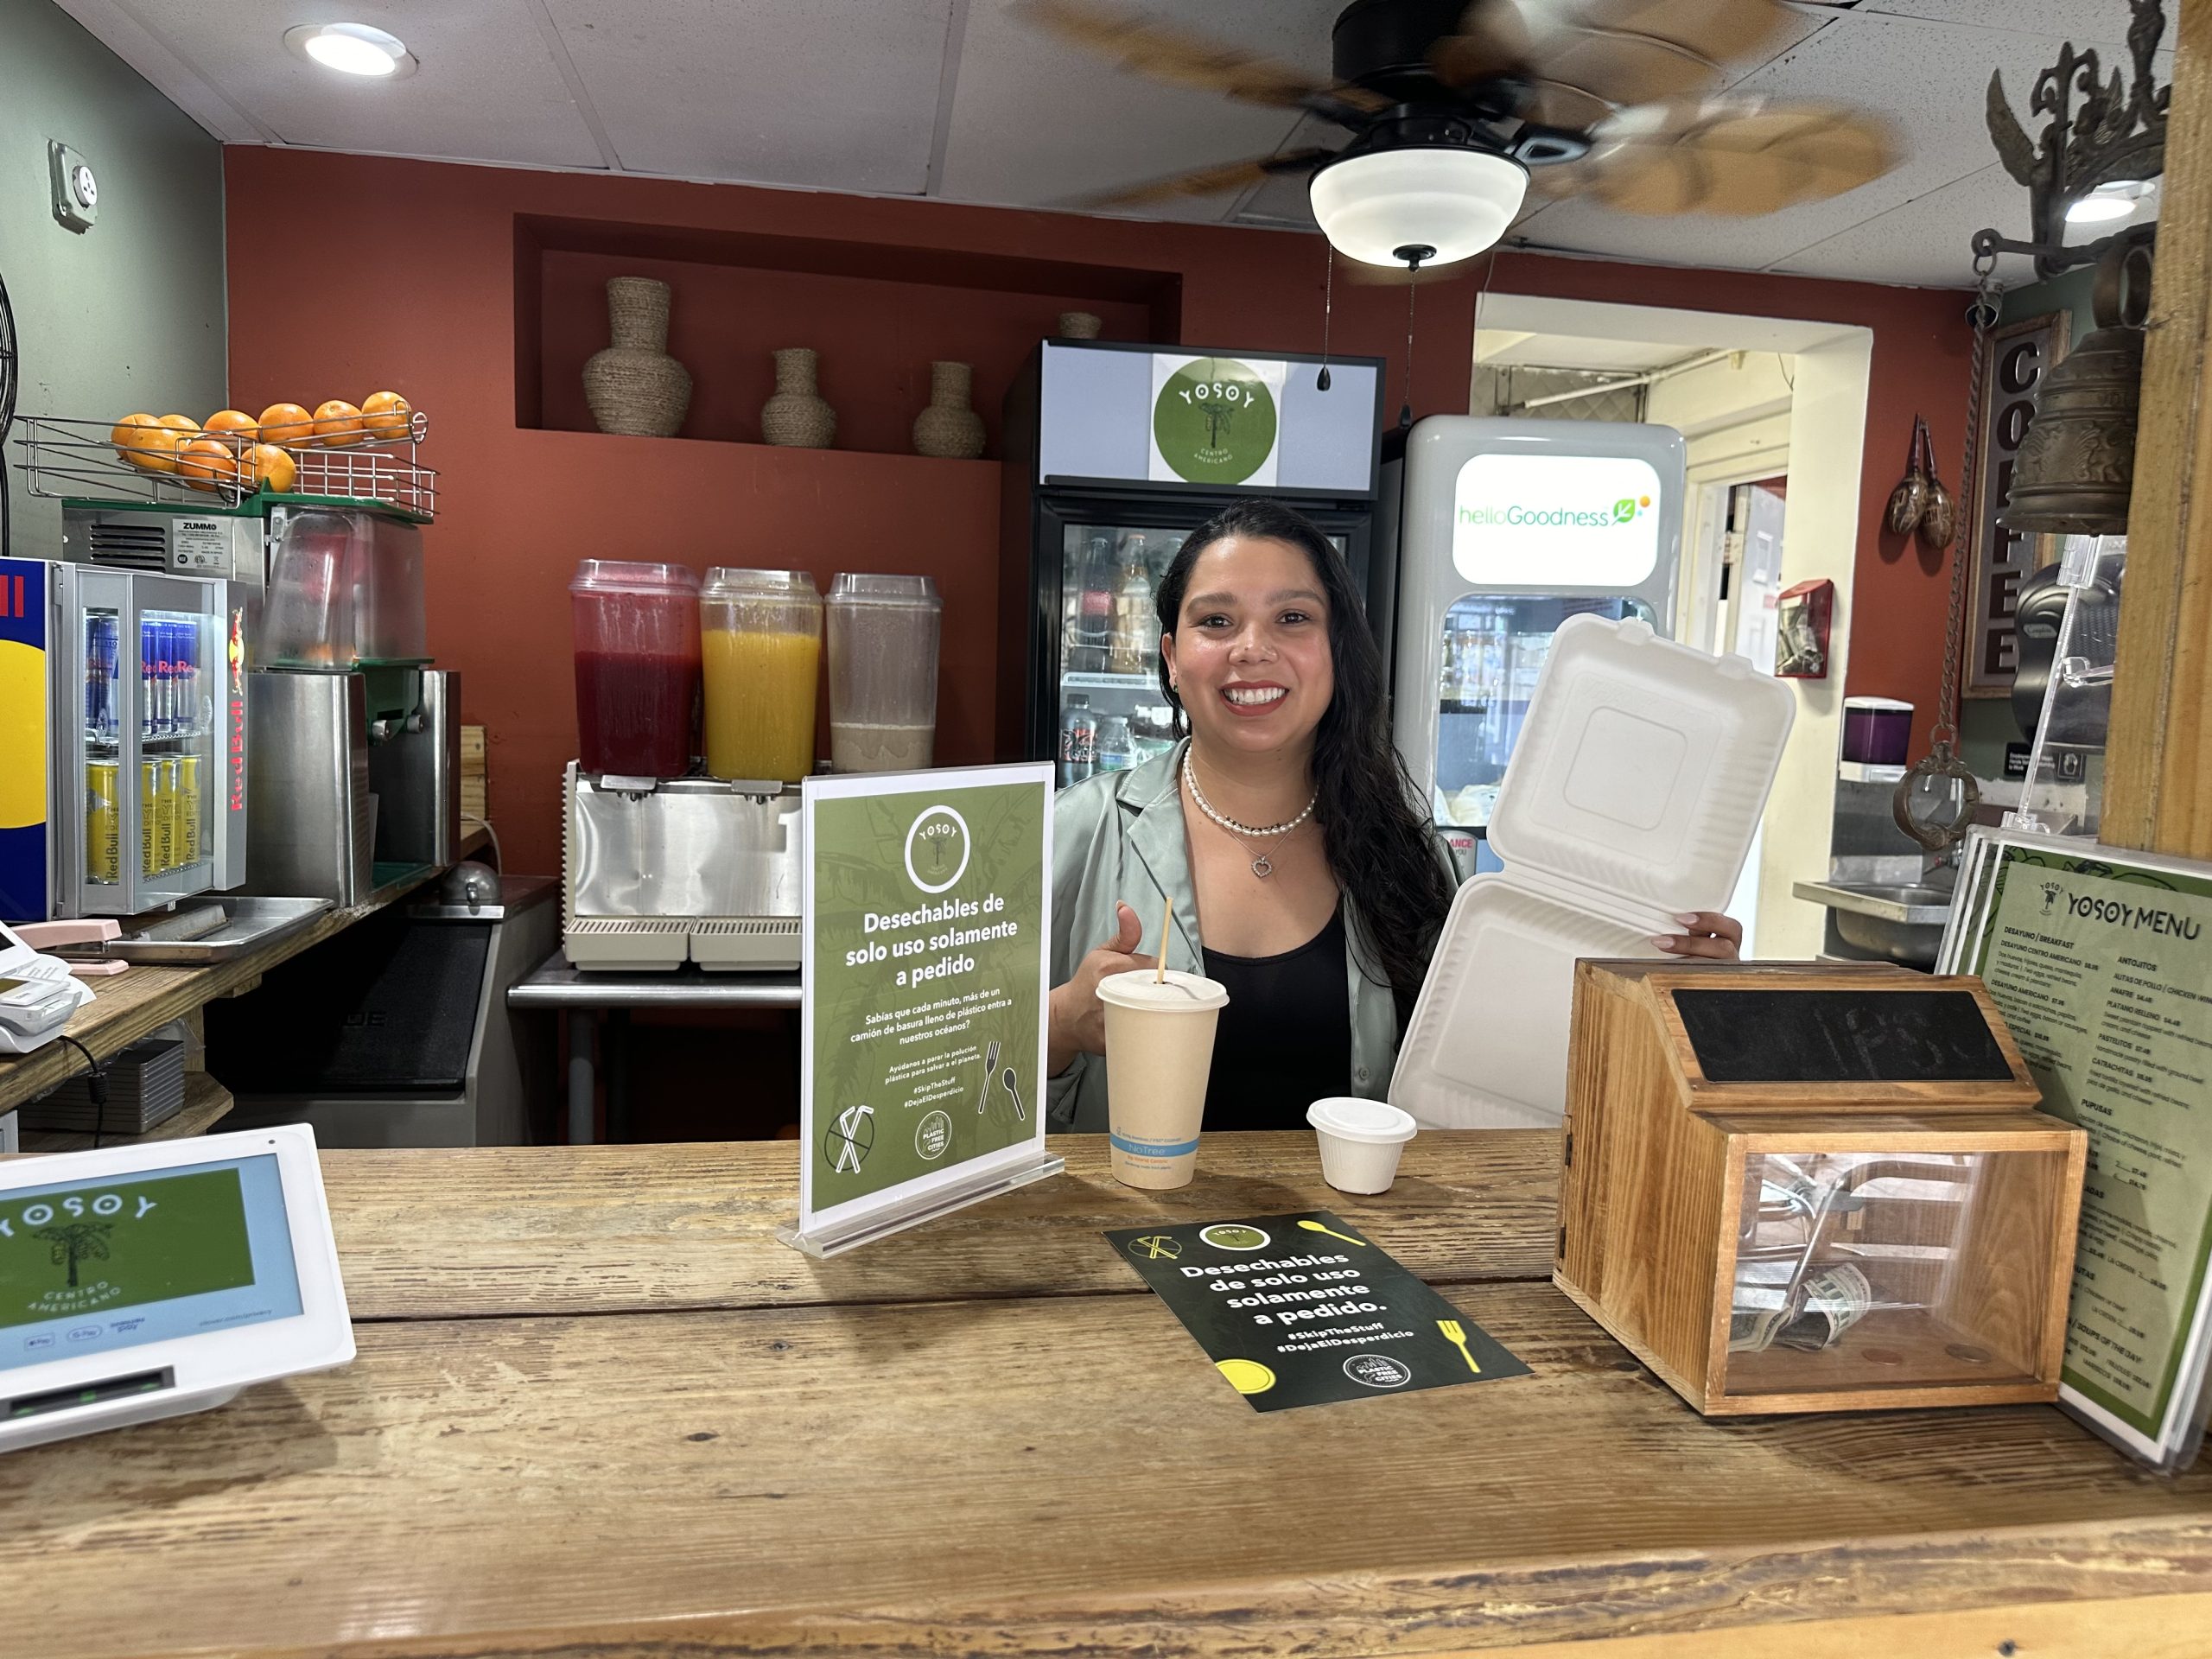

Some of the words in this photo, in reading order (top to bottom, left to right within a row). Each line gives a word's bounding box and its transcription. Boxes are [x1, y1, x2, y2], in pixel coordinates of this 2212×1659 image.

[1179, 382, 1255, 408] YOSOY
[1194, 454, 1233, 465] AMERICANO
[1201, 448, 1229, 456] CENTRO
[183, 522, 216, 531] ZUMMO
[1459, 505, 1609, 527] helloGoodness
[231, 702, 243, 753] Bull
[231, 757, 242, 810] Red
[161, 823, 170, 843] Bull
[187, 819, 195, 837] Bull
[919, 823, 957, 840] YOSOY
[105, 833, 118, 855] Bull
[143, 830, 151, 849] Bull
[1450, 838, 1473, 849] ANCE
[161, 845, 169, 866] Red
[187, 840, 195, 861] Red
[105, 857, 118, 878] Red
[864, 899, 979, 933] Desechables
[983, 893, 1004, 913] de
[2067, 892, 2133, 927] YOSOY
[2133, 906, 2202, 940] MENU
[845, 941, 887, 966] solo
[892, 938, 925, 957] uso
[929, 921, 1018, 950] solamente
[2005, 926, 2036, 940] DESAYUNO
[2039, 935, 2075, 949] BREAKFAST
[2001, 940, 2027, 952] DESAYUNO
[2028, 947, 2048, 957] CENTRO
[2049, 952, 2082, 966] AMERICANO
[2117, 956, 2157, 971] ANTOJITOS
[895, 970, 907, 986] a
[912, 954, 975, 988] pedido
[1991, 979, 2018, 992] DESAYUNO
[2018, 988, 2049, 1001] AMERICANO
[2110, 987, 2134, 998] ANAFRE
[866, 1012, 893, 1025] Sabías
[895, 1008, 911, 1020] que
[912, 1002, 931, 1014] cada
[933, 996, 961, 1010] minuto,
[963, 992, 978, 1002] más
[980, 989, 989, 999] de
[990, 988, 1001, 997] un
[2107, 1001, 2133, 1013] PLATANO
[2134, 1008, 2160, 1020] RELLENO
[850, 1028, 881, 1042] camión
[883, 1025, 895, 1035] de
[897, 1020, 923, 1032] basura
[925, 1014, 944, 1025] lleno
[946, 1011, 956, 1020] de
[957, 1004, 986, 1020] plástico
[987, 1000, 1006, 1009] entra
[2008, 1023, 2031, 1036] ESPECIAL
[899, 1030, 933, 1046] nuestros
[935, 1020, 970, 1037] océanos?
[2098, 1033, 2133, 1049] PASTELITOS
[885, 1071, 909, 1085] plástica
[911, 1067, 925, 1078] para
[926, 1063, 944, 1073] salvar
[950, 1058, 957, 1066] el
[957, 1053, 982, 1065] planeta.
[888, 1060, 920, 1073] Ayúdanos
[926, 1054, 944, 1066] parar
[951, 1045, 976, 1058] polución
[2092, 1058, 2133, 1077] CATRACHITAS
[913, 1077, 956, 1094] #SkipTheStuff
[904, 1086, 964, 1108] #DejaElDesperdicio
[2081, 1099, 2113, 1116] PUPUSAS
[923, 1128, 944, 1139] PLASTIC
[928, 1141, 944, 1151] CITIES
[1128, 1144, 1166, 1155] NoTree
[0, 1194, 157, 1237] YOSOY
[1180, 1253, 1350, 1278] Desechables
[2075, 1265, 2095, 1281] UTAS
[1210, 1279, 1246, 1292] de
[1251, 1274, 1308, 1287] solo
[1313, 1268, 1361, 1281] uso
[28, 1287, 121, 1312] AMERICANO
[44, 1281, 109, 1301] CENTRO
[1227, 1284, 1370, 1308] solamente
[1253, 1314, 1274, 1325] a
[1276, 1301, 1388, 1325] pedido.
[1287, 1322, 1384, 1339] #SkipTheStuff
[1277, 1331, 1414, 1353] #DejaElDesperdicio
[1358, 1365, 1393, 1374] PLASTIC
